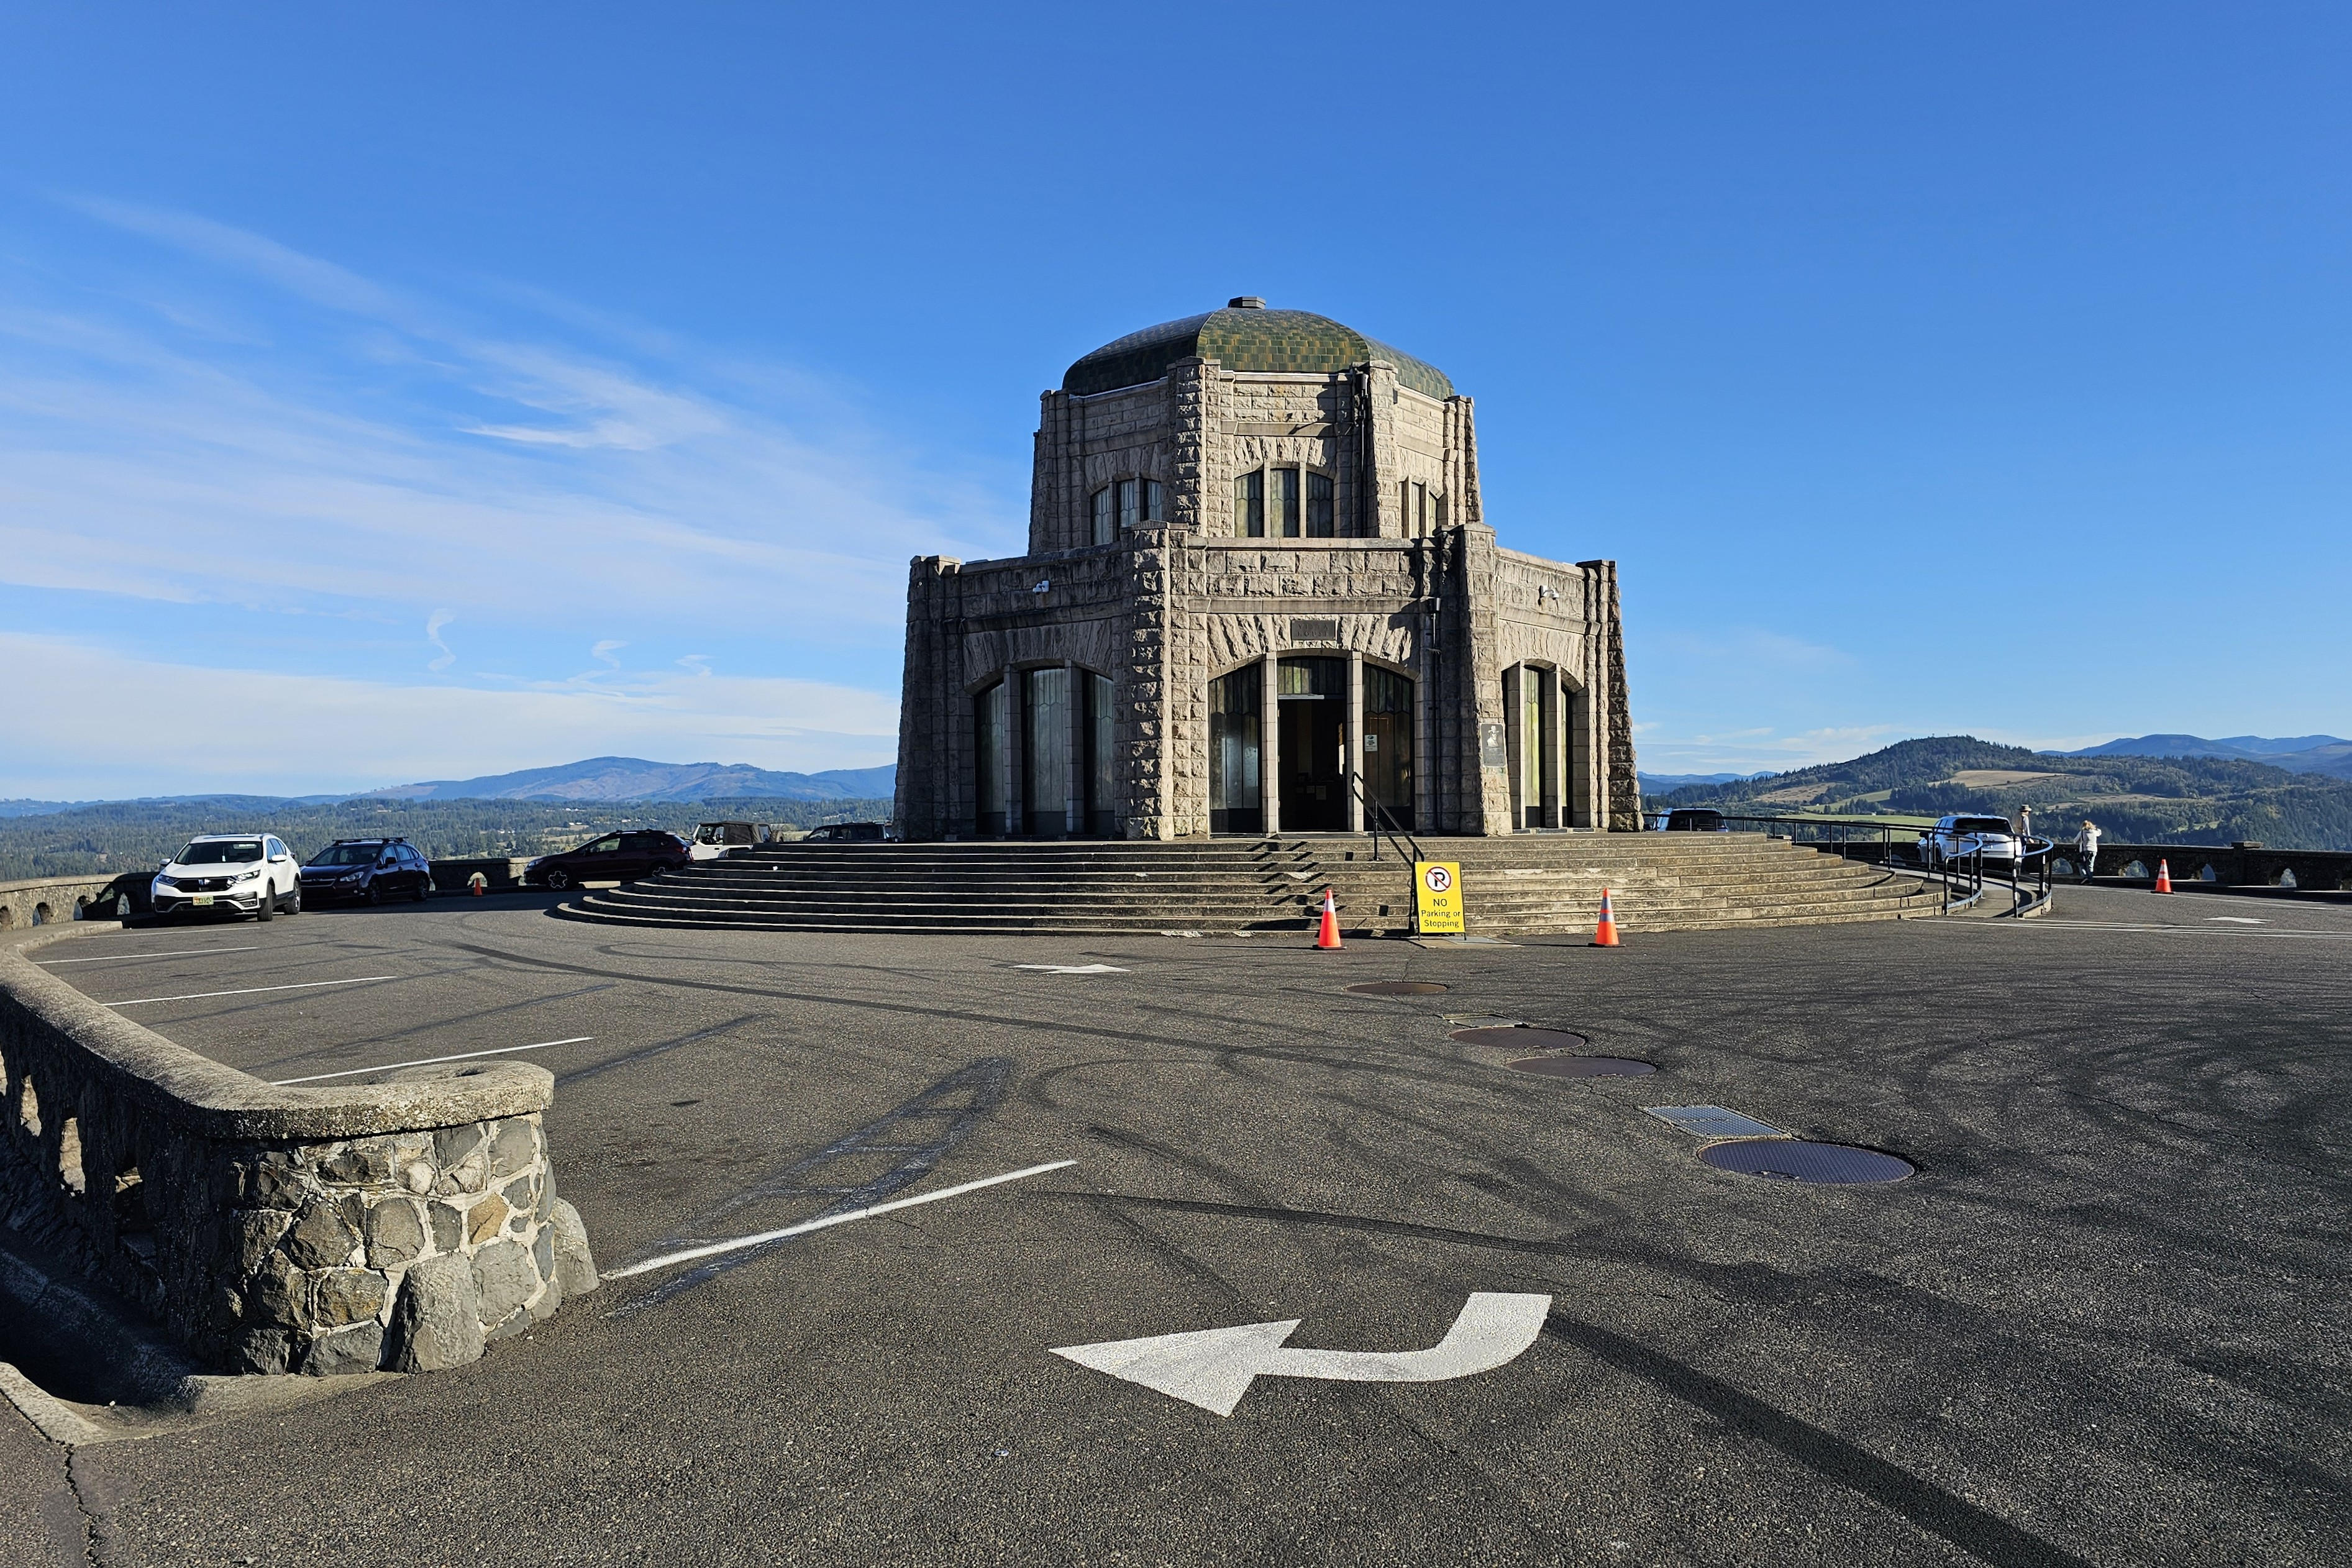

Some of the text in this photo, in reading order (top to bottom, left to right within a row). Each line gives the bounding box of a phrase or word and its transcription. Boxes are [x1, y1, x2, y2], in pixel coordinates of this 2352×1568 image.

[1433, 898, 1447, 906] NO
[1421, 909, 1451, 918] Parking
[1424, 919, 1459, 928] Stopping
